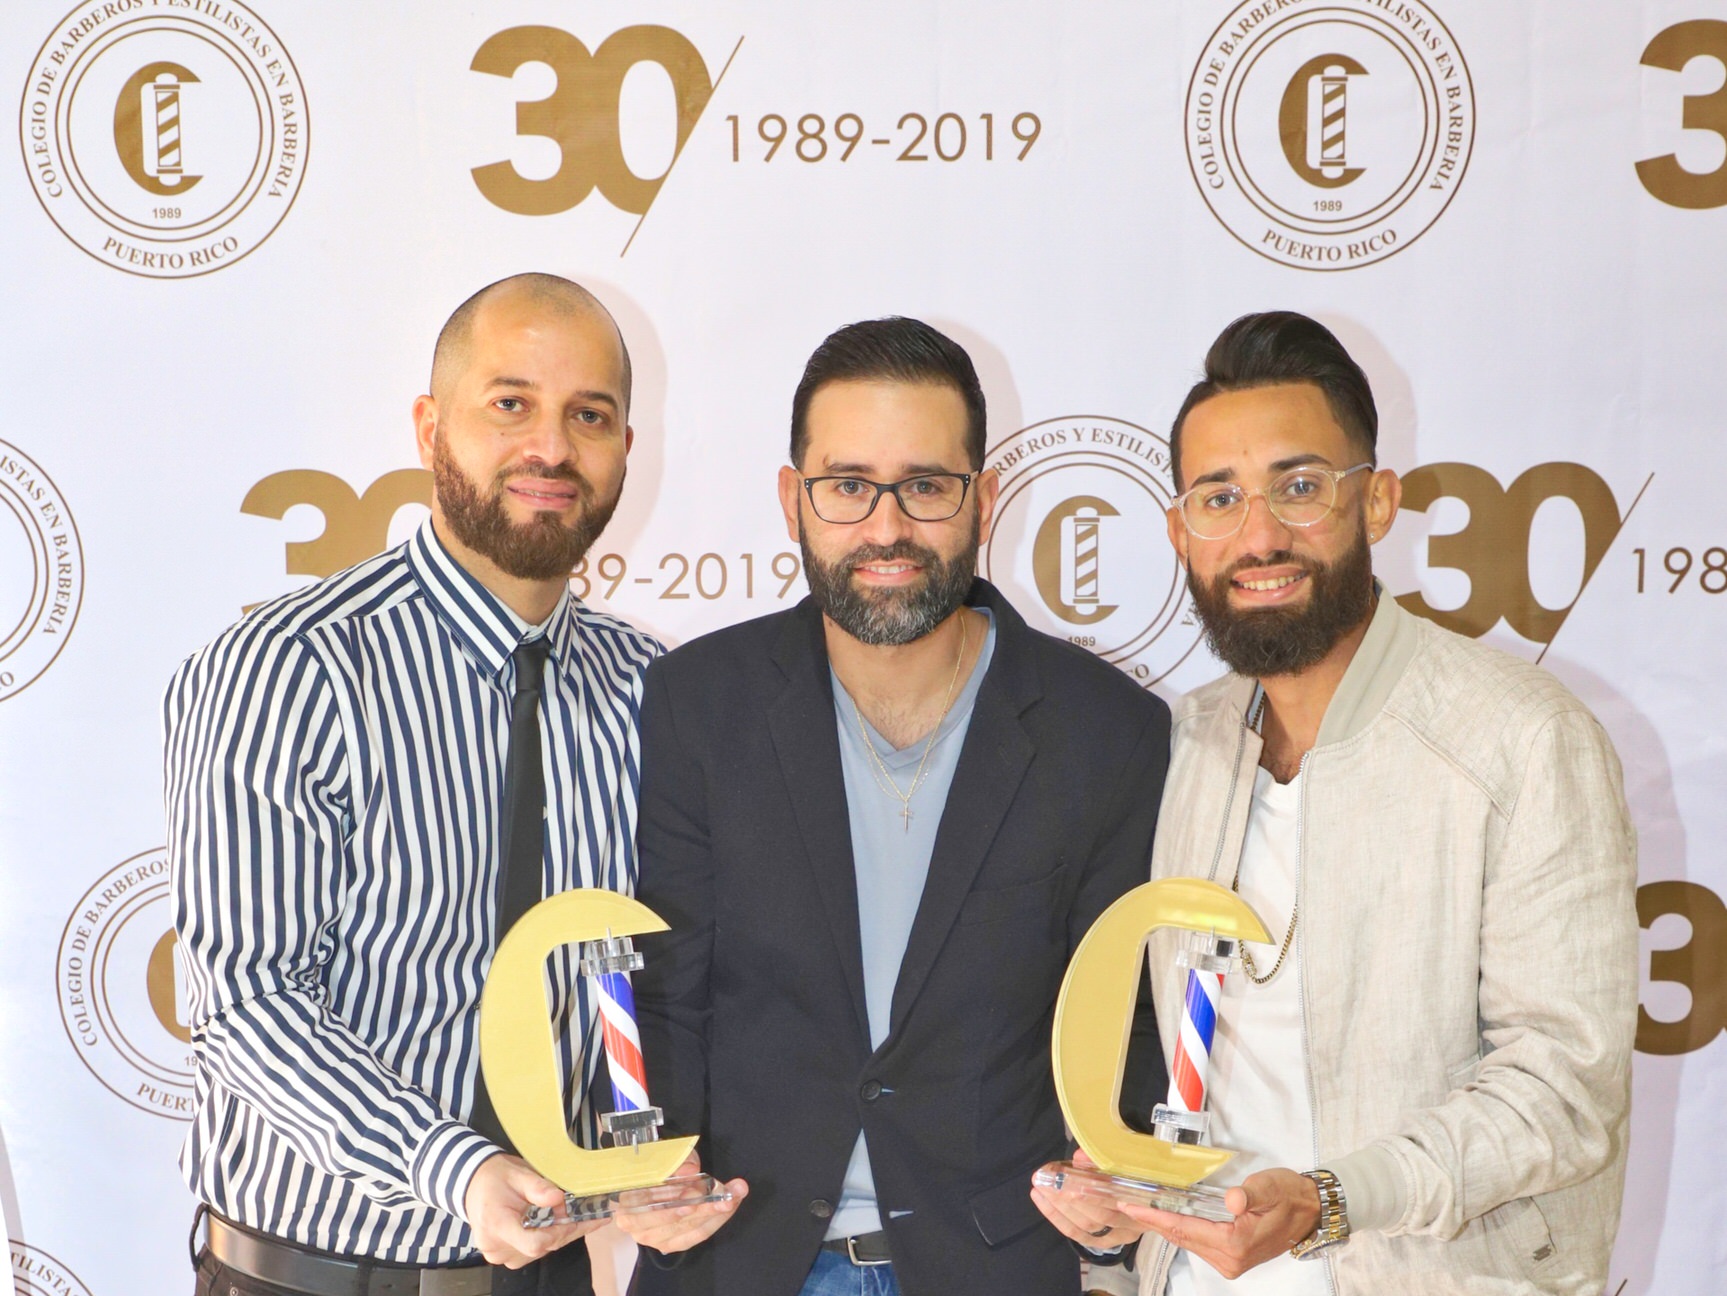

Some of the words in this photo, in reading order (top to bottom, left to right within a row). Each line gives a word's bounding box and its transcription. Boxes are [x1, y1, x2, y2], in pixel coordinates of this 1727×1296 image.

[50, 0, 143, 65] BARBEROS
[37, 67, 58, 95] DE
[266, 59, 289, 88] EN
[1203, 58, 1225, 88] DE
[1435, 52, 1458, 81] EN
[31, 101, 63, 198] COLEGIO
[268, 92, 298, 199] BARBERIA
[725, 111, 1042, 163] 1989-2019
[1196, 92, 1225, 190] COLEGIO
[1429, 85, 1463, 192] BARBERIA
[152, 207, 181, 219] 1989
[1313, 200, 1343, 212] 1989
[102, 236, 184, 270] PUERTO
[189, 236, 238, 266] RICO
[1261, 229, 1342, 262] PUERTO
[1348, 228, 1398, 260] RICO
[1072, 427, 1085, 441] Y
[40, 502, 63, 530] EN
[43, 533, 72, 634] BARBERIA
[71, 926, 91, 952] DE
[67, 957, 98, 1046] COLEGIO
